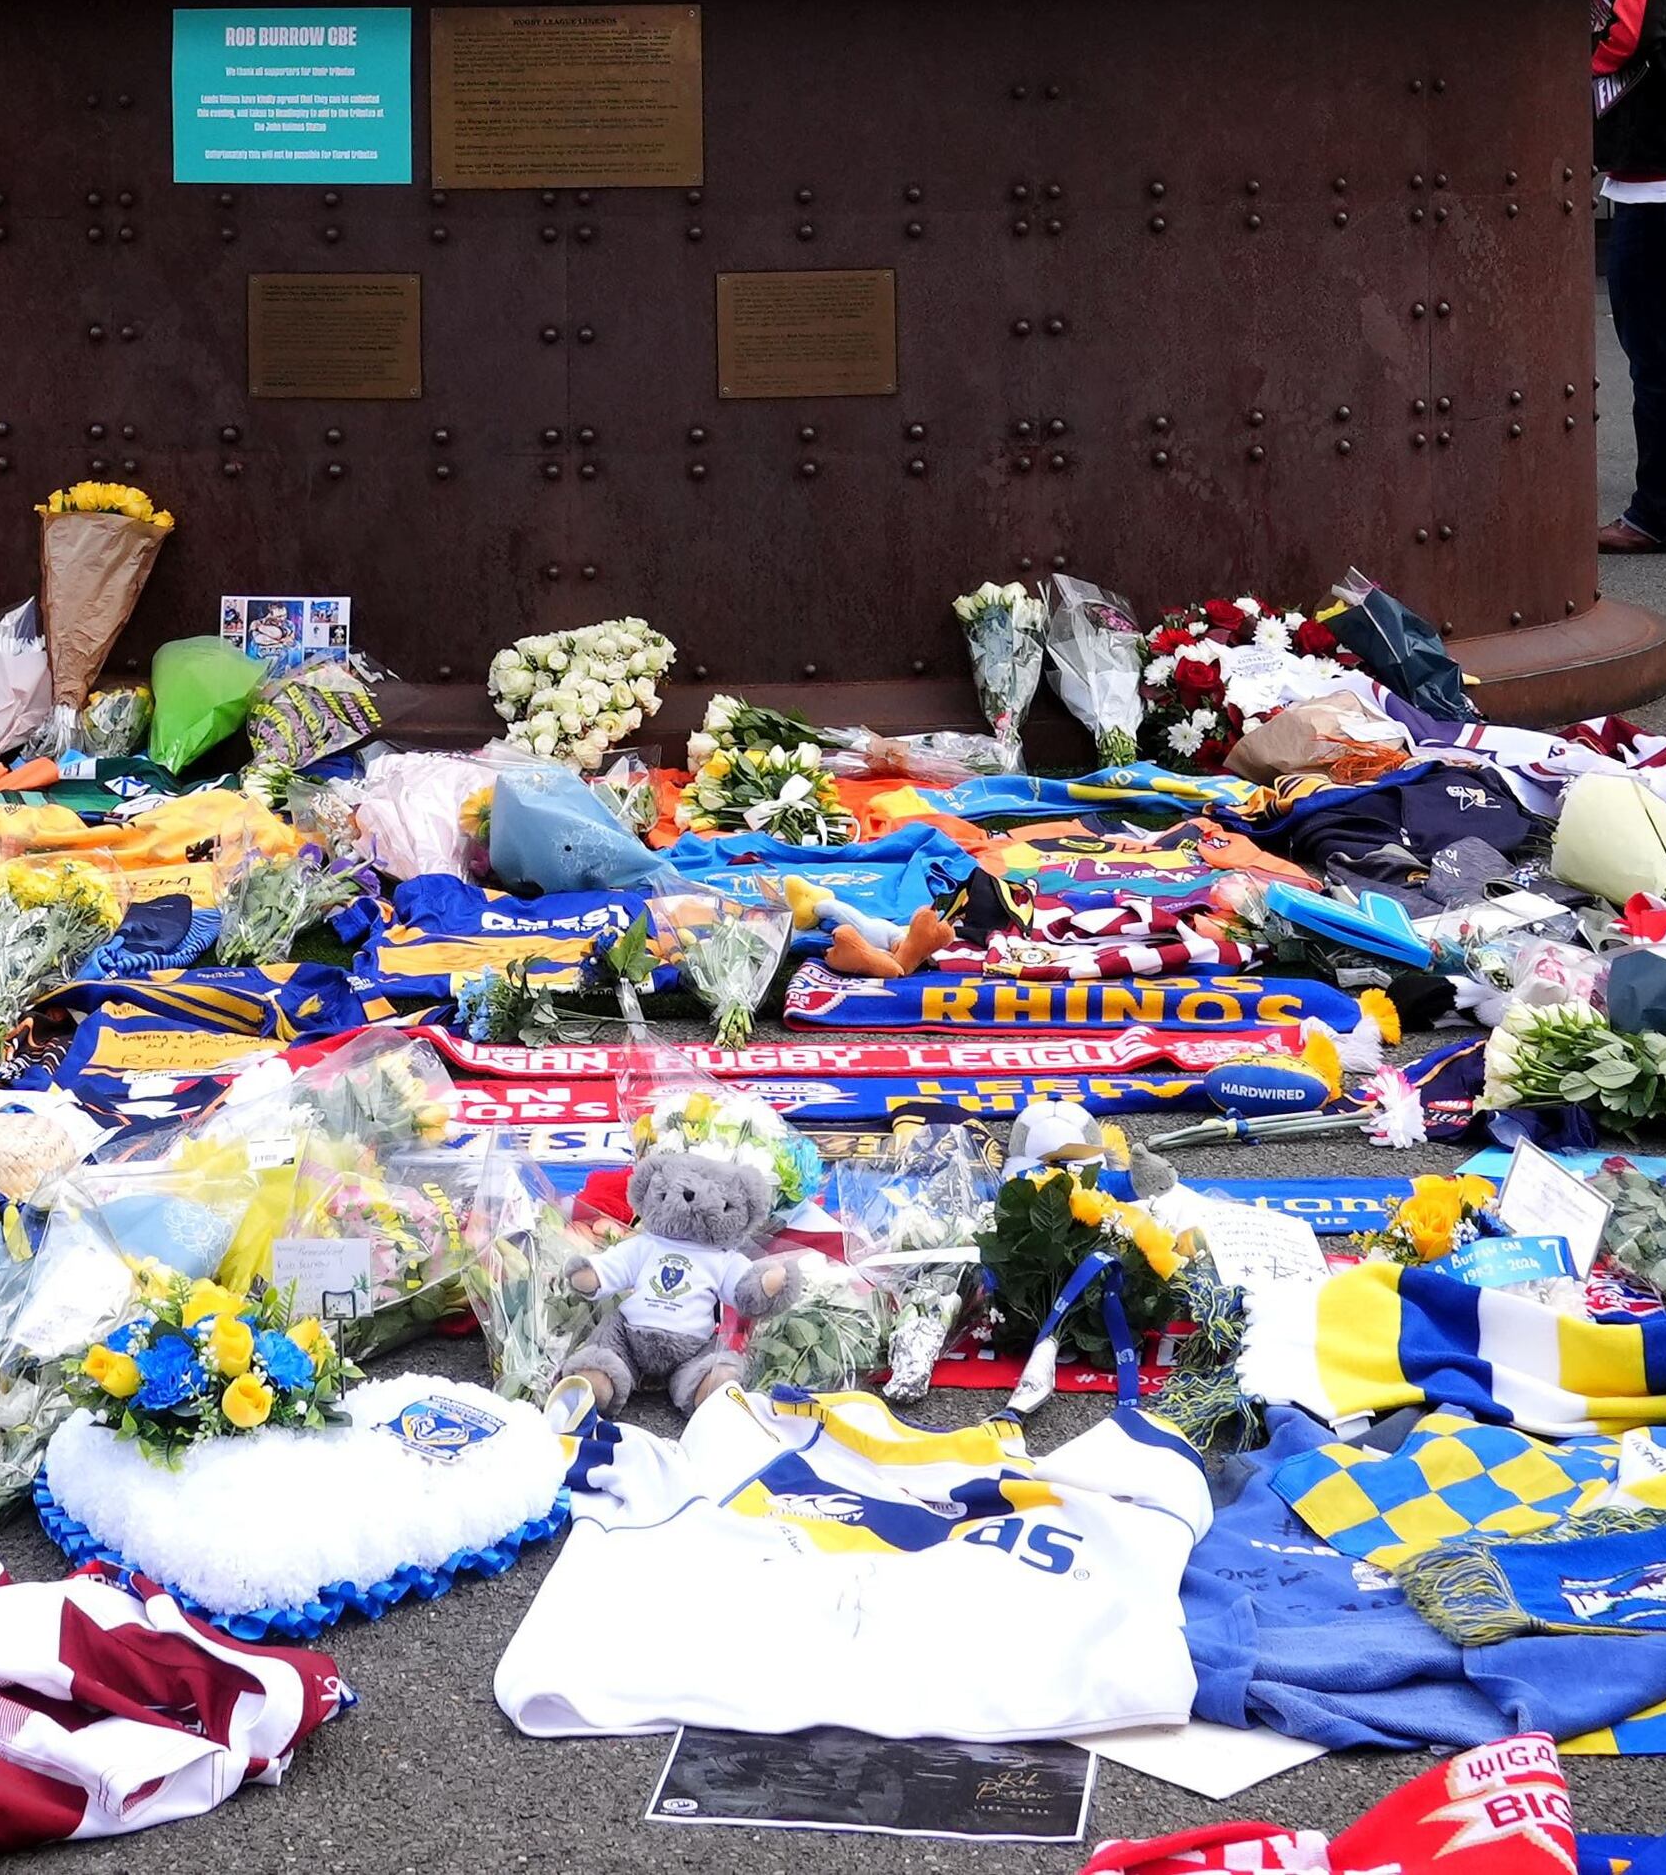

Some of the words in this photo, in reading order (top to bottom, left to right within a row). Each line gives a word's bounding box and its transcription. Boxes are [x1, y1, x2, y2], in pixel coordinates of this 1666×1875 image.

[225, 26, 255, 46] ROB
[259, 26, 325, 46] BURROW
[920, 984, 1304, 1026] RHINOS
[907, 1031, 1155, 1069] LEAGUE
[1220, 1082, 1305, 1101] HARDWIRED
[1506, 1255, 1541, 1273] 2024
[999, 1770, 1039, 1788] Rob
[976, 1780, 1055, 1801] Burrow
